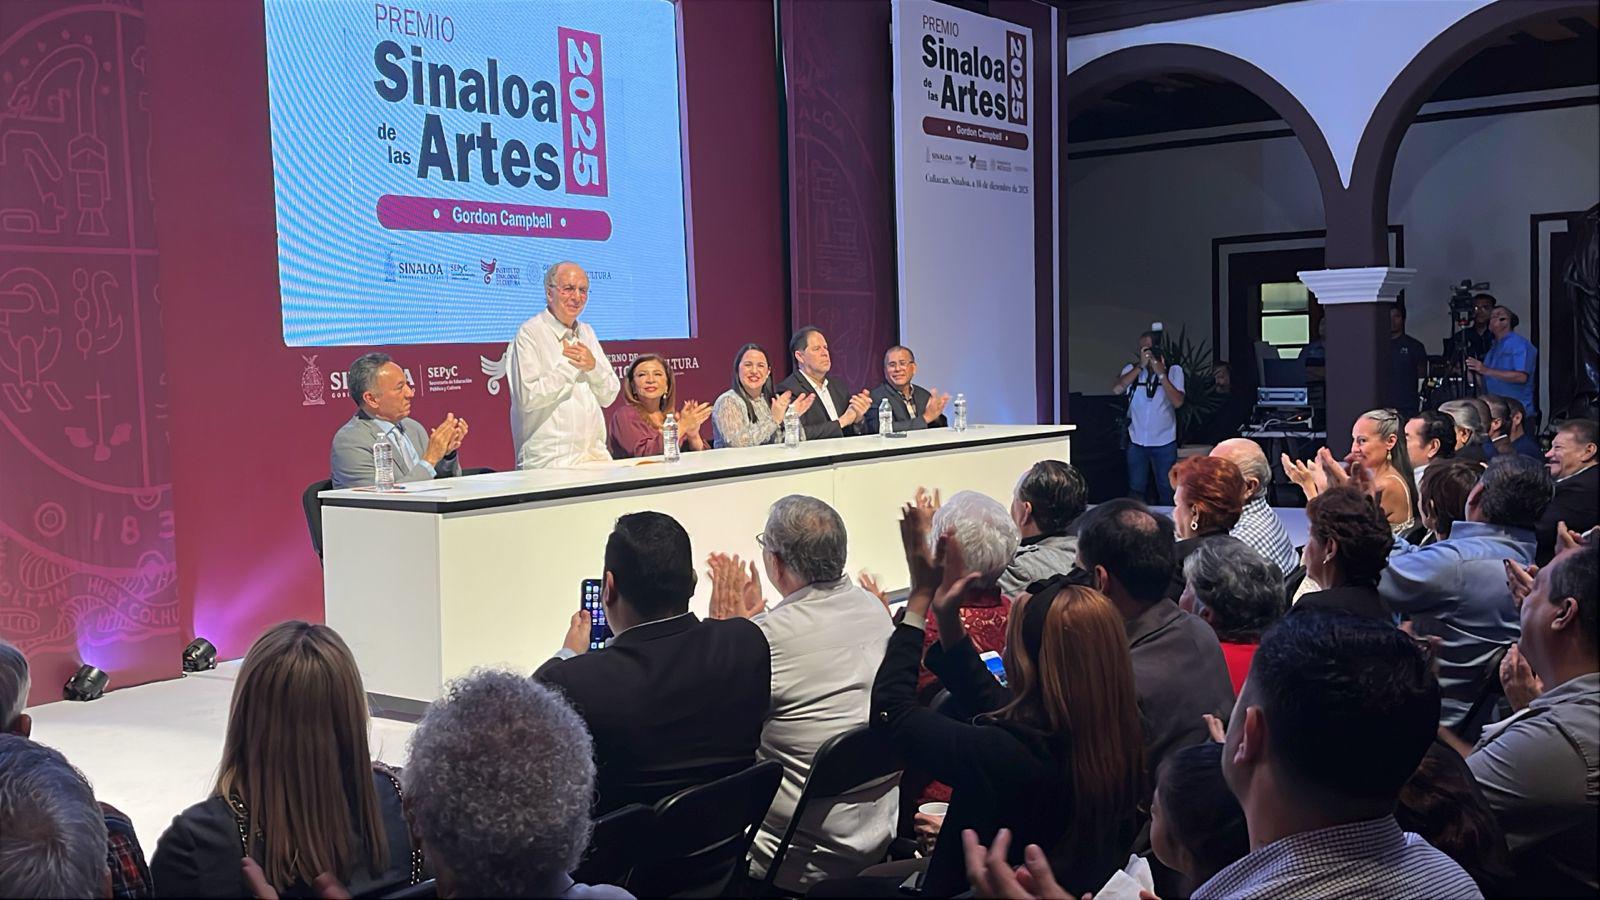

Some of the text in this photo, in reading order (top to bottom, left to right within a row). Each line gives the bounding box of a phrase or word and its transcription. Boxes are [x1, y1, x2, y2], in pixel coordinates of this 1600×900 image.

[374, 3, 455, 43] PREMIO
[922, 15, 959, 37] PREMIO
[922, 34, 1005, 83] Sinaloa
[373, 40, 558, 123] Sinaloa
[923, 77, 932, 88] de
[1010, 36, 1024, 120] 2025
[928, 90, 938, 101] las
[941, 74, 1006, 120] Artes
[567, 38, 600, 187] 2025
[377, 122, 397, 141] de
[956, 125, 1002, 141] Gordon Campbell
[388, 146, 412, 165] las
[417, 113, 561, 191] Artes
[931, 152, 952, 161] SINALOA
[452, 206, 552, 231] Gordon Campbell
[398, 262, 444, 275] SINALOA
[607, 353, 628, 363] ERNO
[427, 366, 458, 380] SEPyC
[129, 602, 180, 627] COLHU
